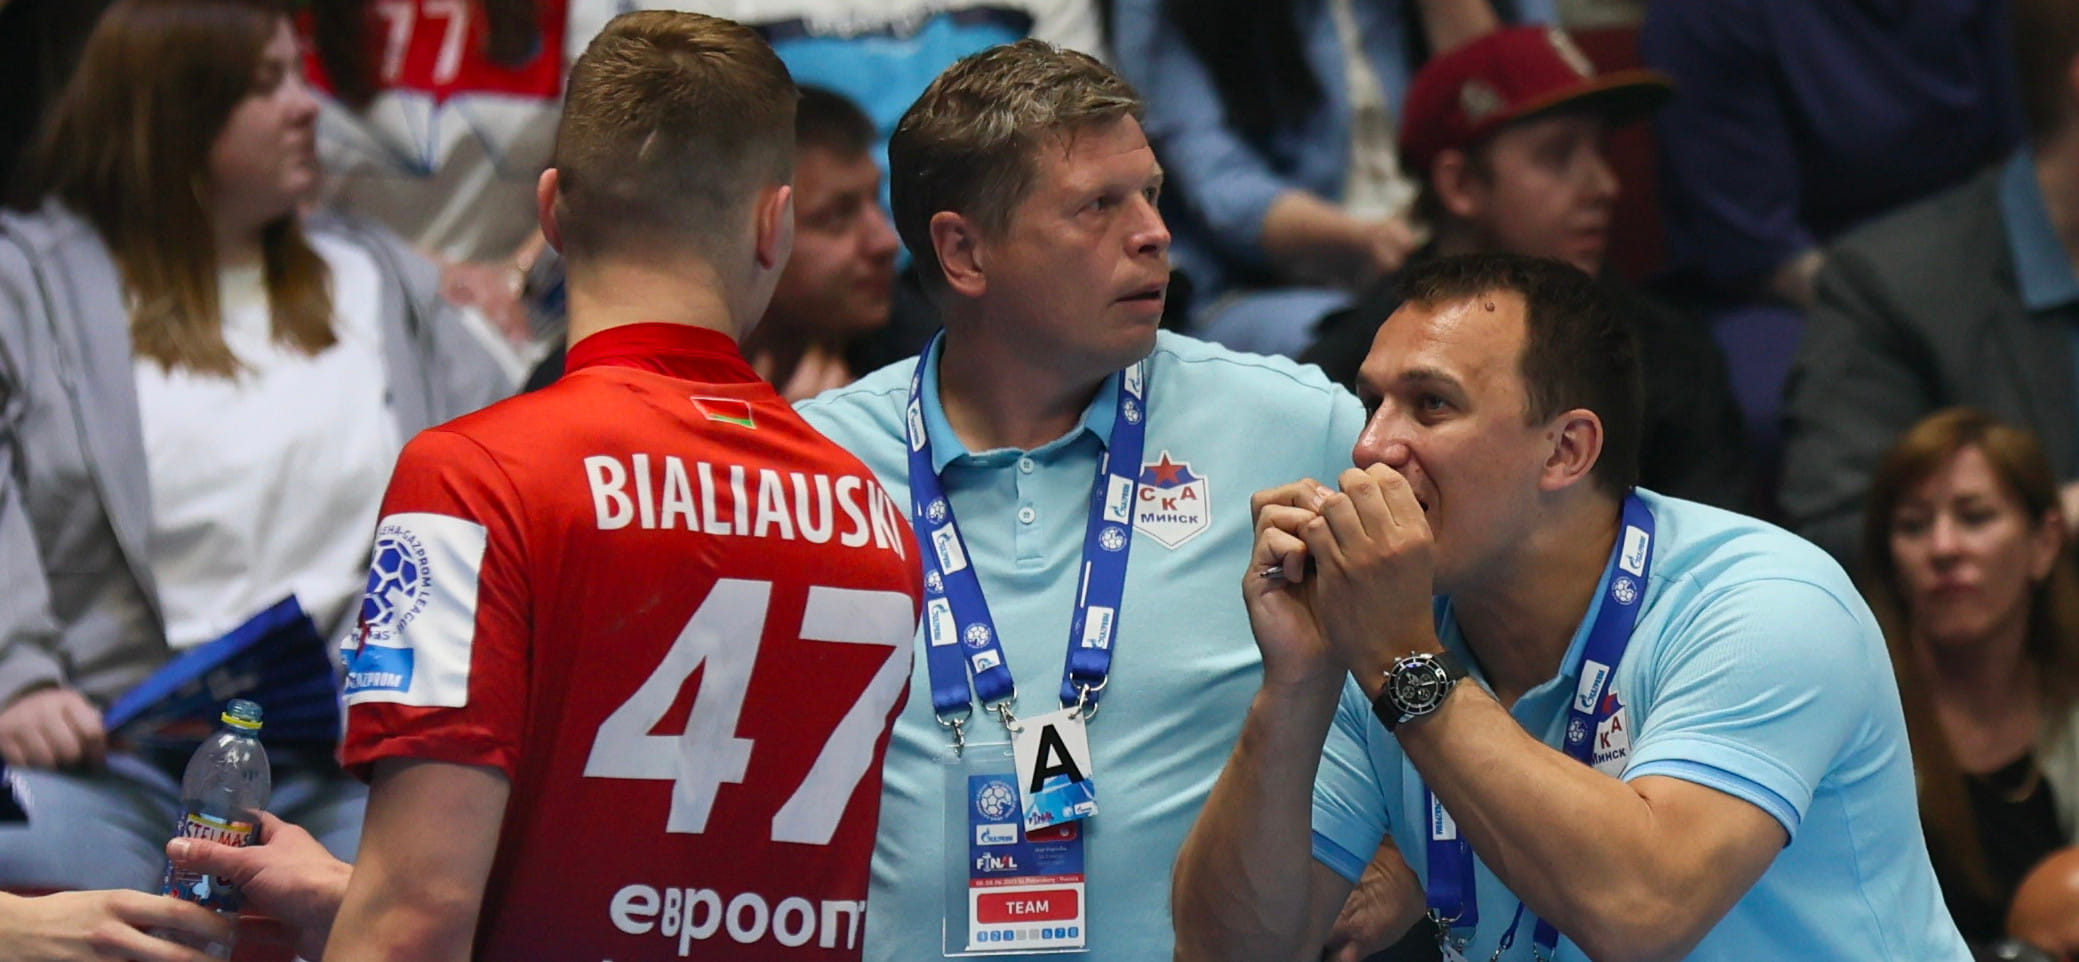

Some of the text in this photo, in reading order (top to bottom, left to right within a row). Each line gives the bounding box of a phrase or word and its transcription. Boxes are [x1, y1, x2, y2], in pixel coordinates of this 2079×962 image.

[584, 453, 906, 562] BIALIAUSKI
[582, 577, 915, 845] 47
[609, 884, 866, 957] еврооп
[1005, 900, 1050, 915] TEAM
